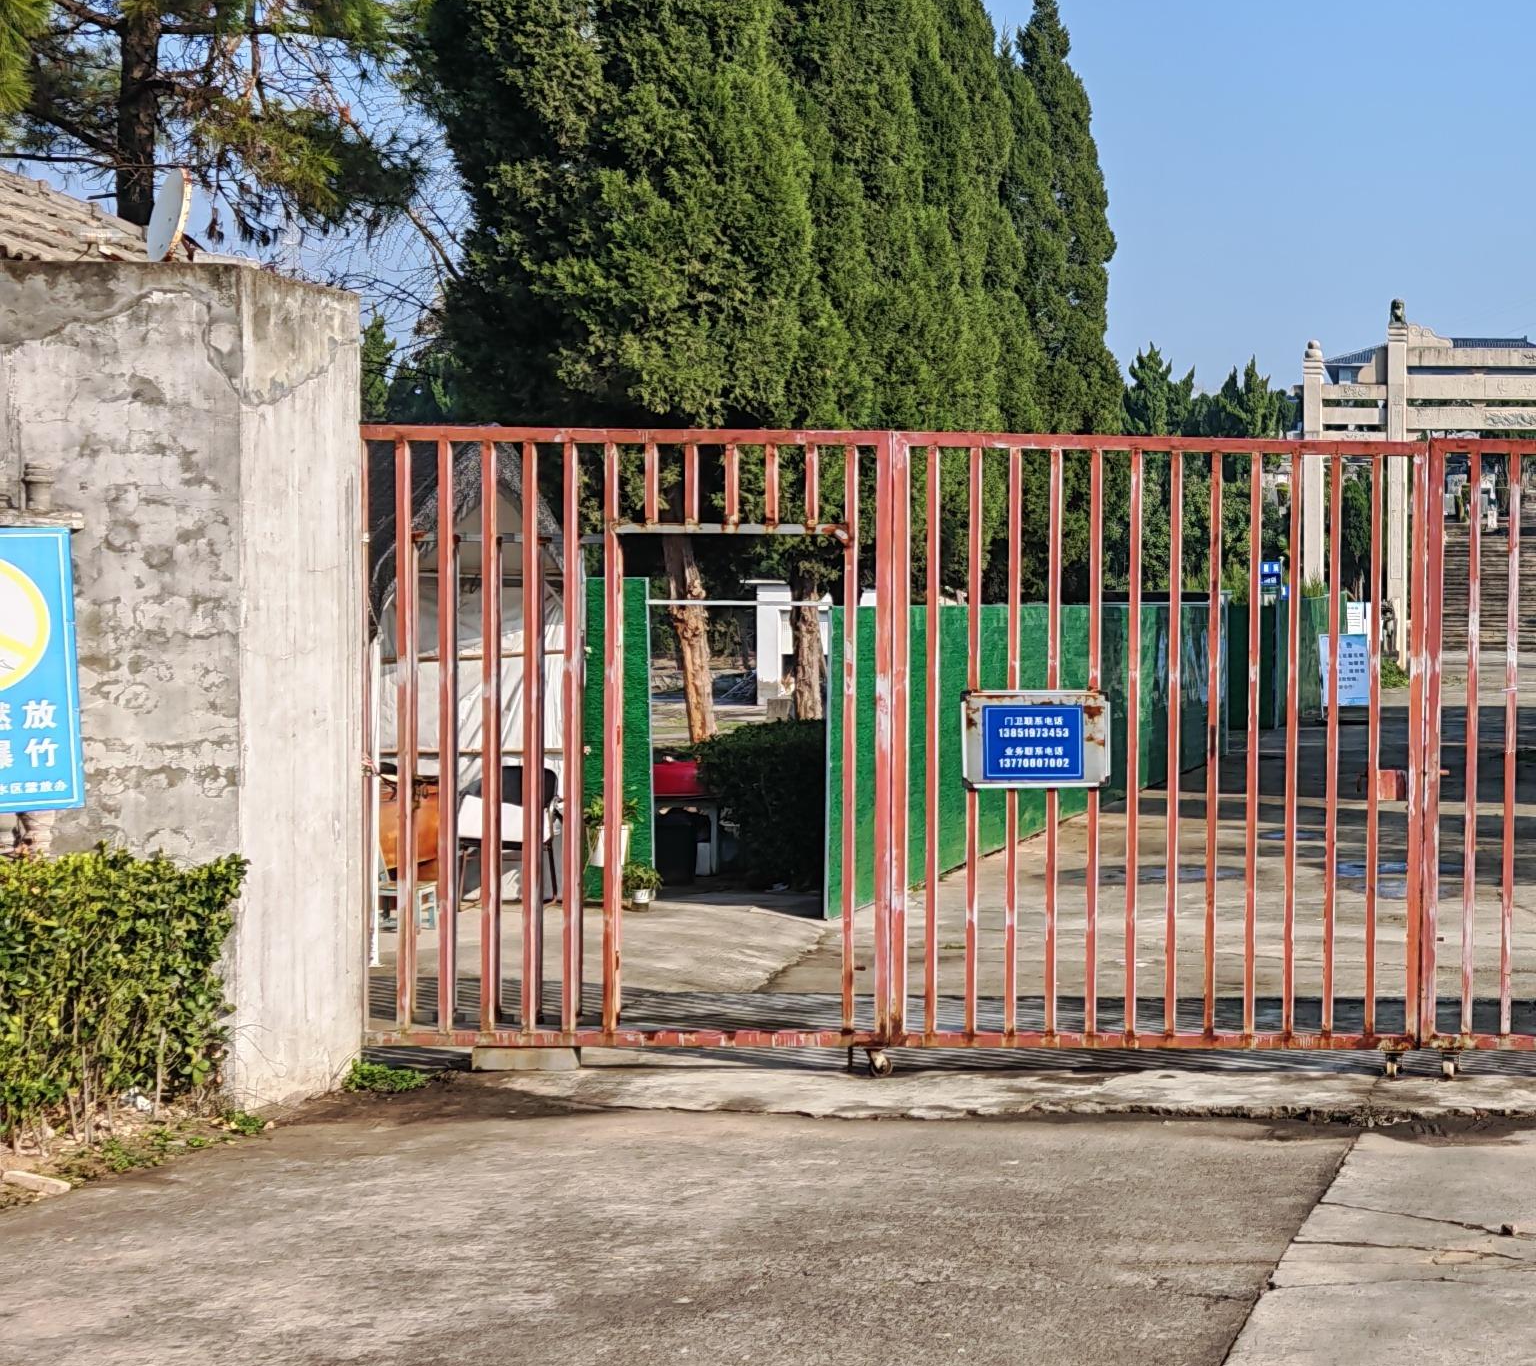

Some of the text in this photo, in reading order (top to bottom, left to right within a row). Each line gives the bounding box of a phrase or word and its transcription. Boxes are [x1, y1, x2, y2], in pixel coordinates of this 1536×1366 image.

[1004, 716, 1064, 726] 门卫联系电话
[1004, 746, 1064, 757] 业务联系电话
